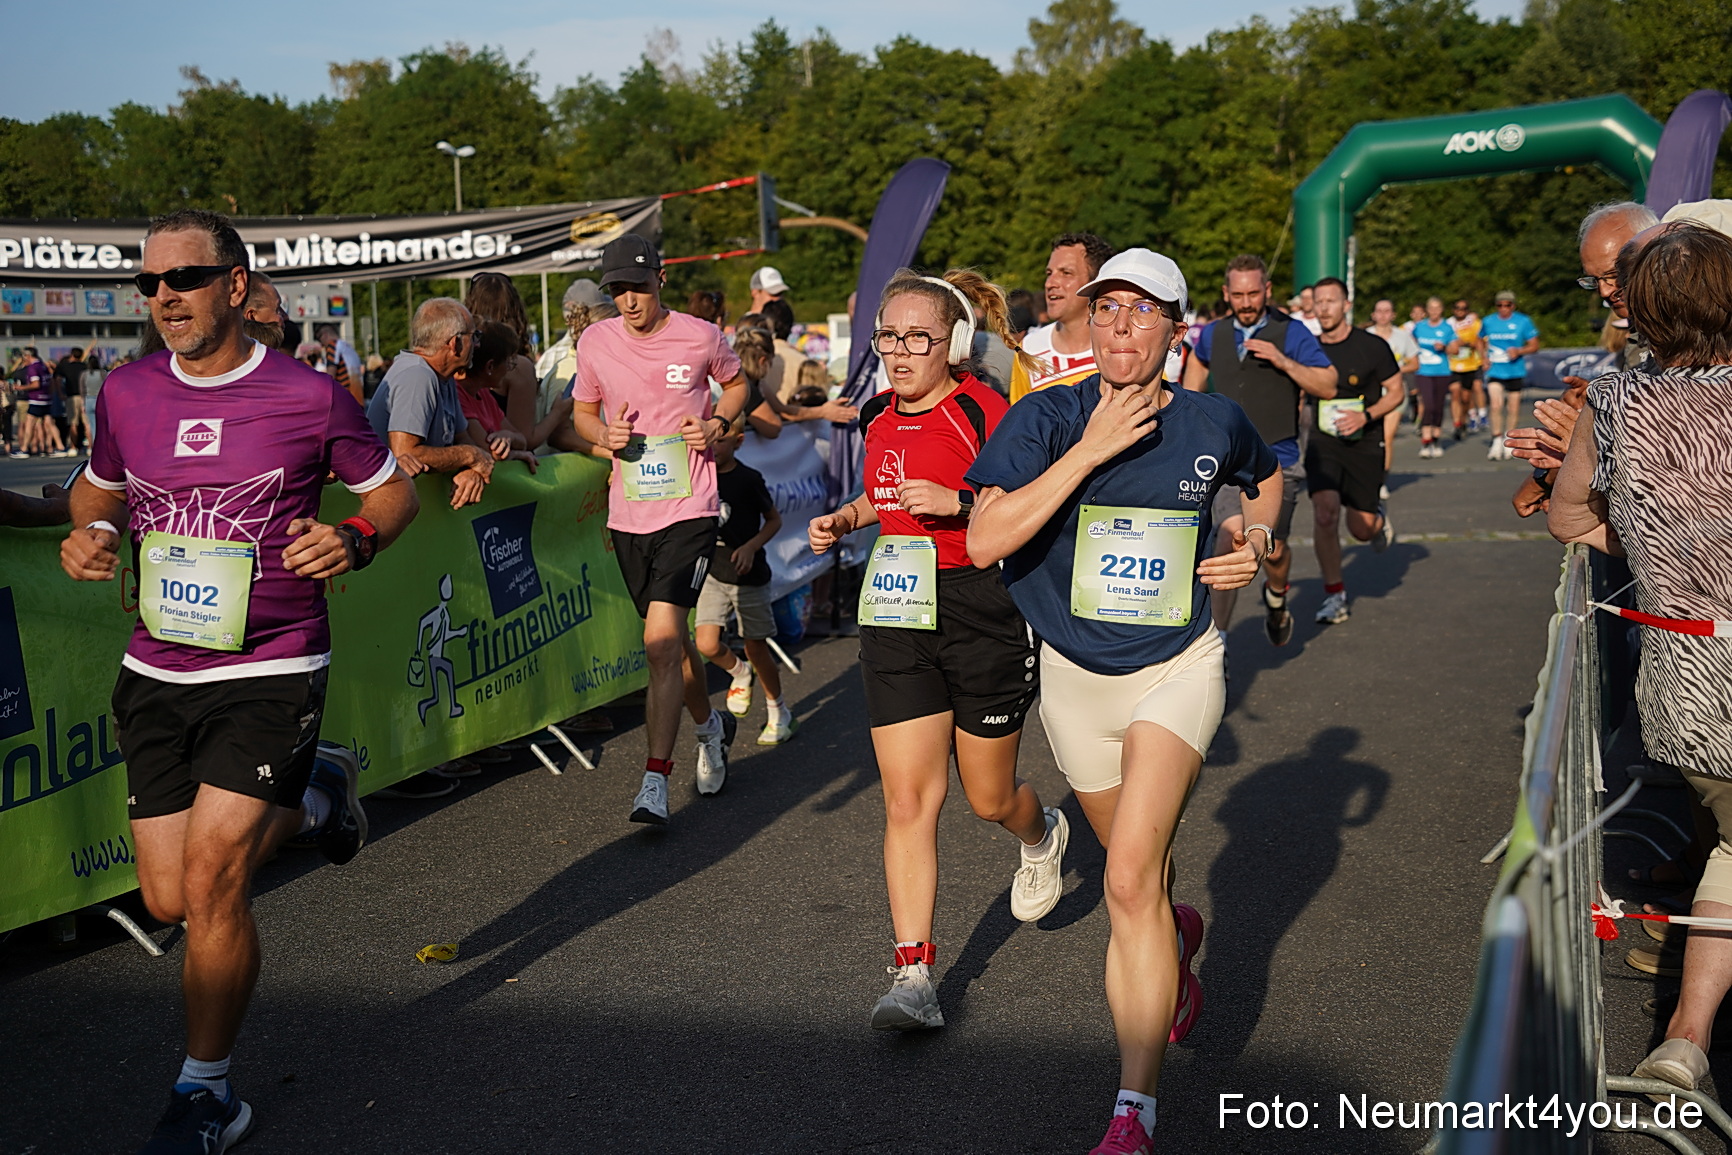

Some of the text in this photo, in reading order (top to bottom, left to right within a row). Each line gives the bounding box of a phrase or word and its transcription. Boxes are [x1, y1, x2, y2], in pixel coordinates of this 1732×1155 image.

[1443, 129, 1497, 155] AOK
[0, 236, 133, 270] Plätze.
[275, 229, 522, 268] Miteinander.
[665, 364, 692, 384] ac
[180, 431, 218, 442] FUCHS
[639, 463, 667, 476] 146
[1107, 528, 1145, 538] Firmenlauf
[489, 536, 523, 564] Fischer
[1100, 554, 1166, 581] 2218
[160, 578, 219, 607] 1002
[872, 572, 919, 592] 4047
[1106, 584, 1160, 597] Lena Sand
[159, 604, 189, 618] Florian
[190, 610, 222, 623] Stigler
[467, 562, 593, 680] firmenlauf
[474, 656, 540, 705] neumarkt
[981, 714, 1009, 725] JAKO
